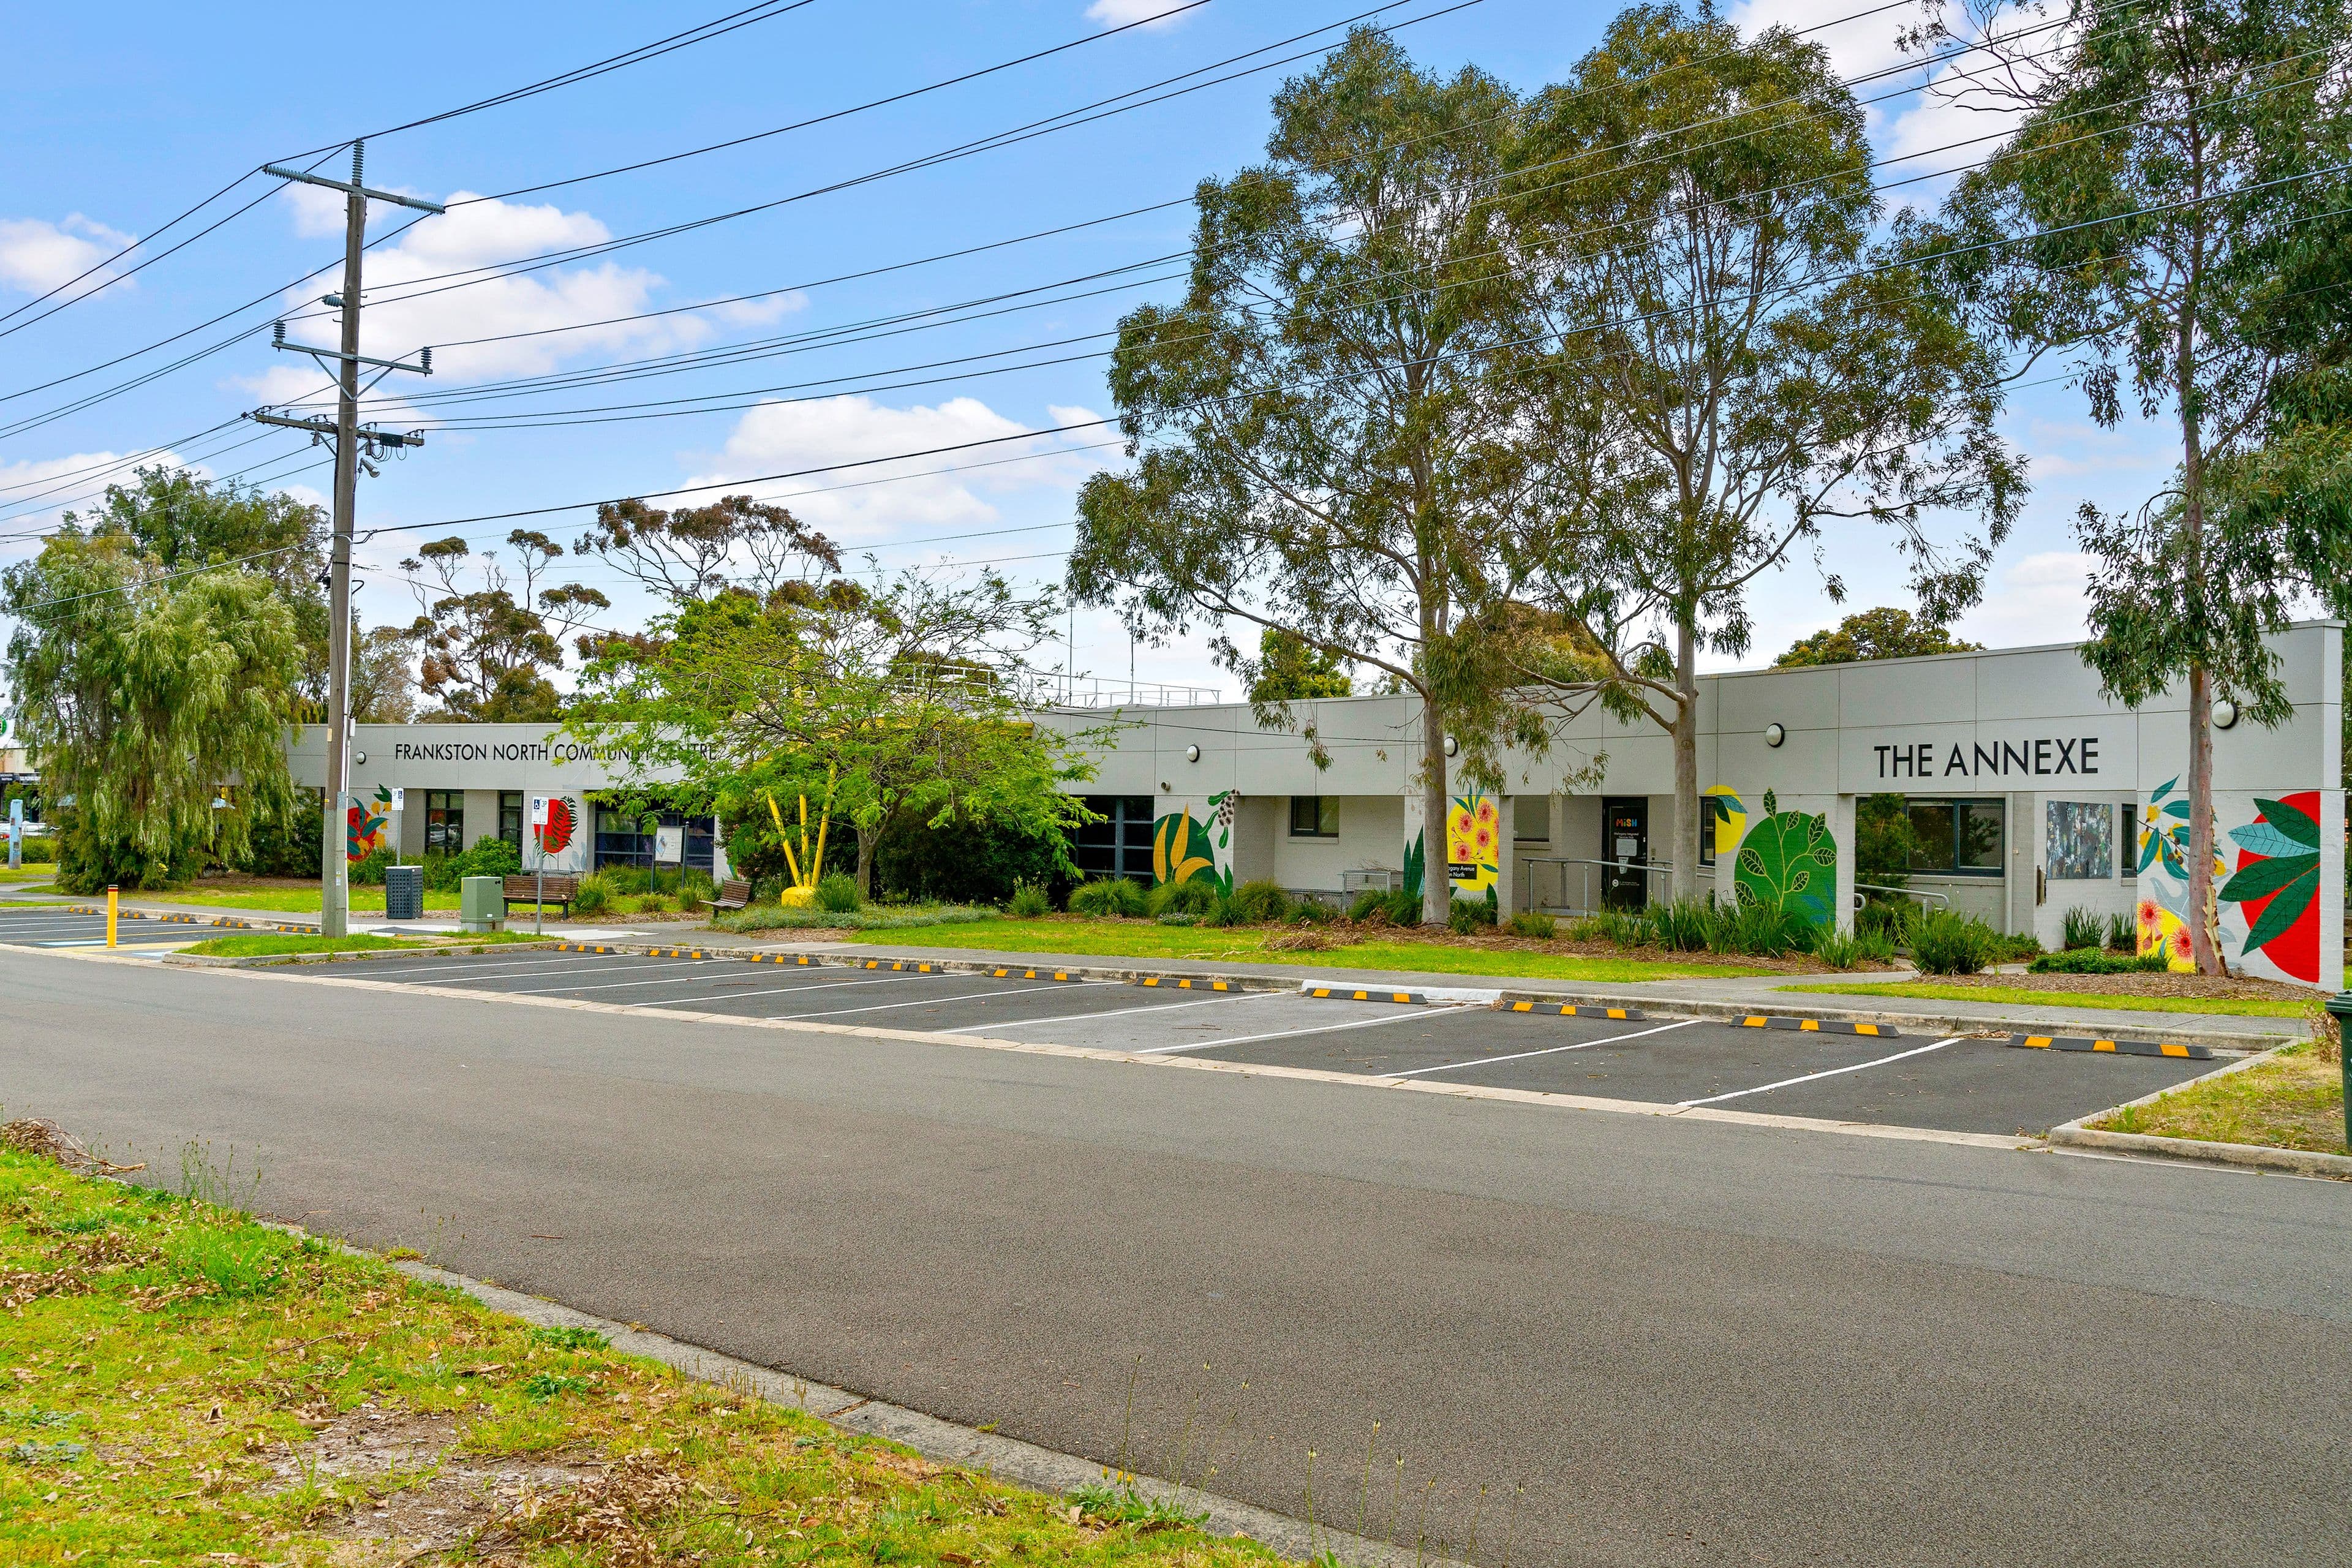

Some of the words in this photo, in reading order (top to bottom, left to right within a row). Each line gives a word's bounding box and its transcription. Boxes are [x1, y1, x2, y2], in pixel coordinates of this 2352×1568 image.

[396, 744, 486, 760] FRANKSTON
[494, 744, 548, 761] NORTH
[1874, 744, 1932, 777] THE
[1944, 737, 2098, 776] ANNEXE
